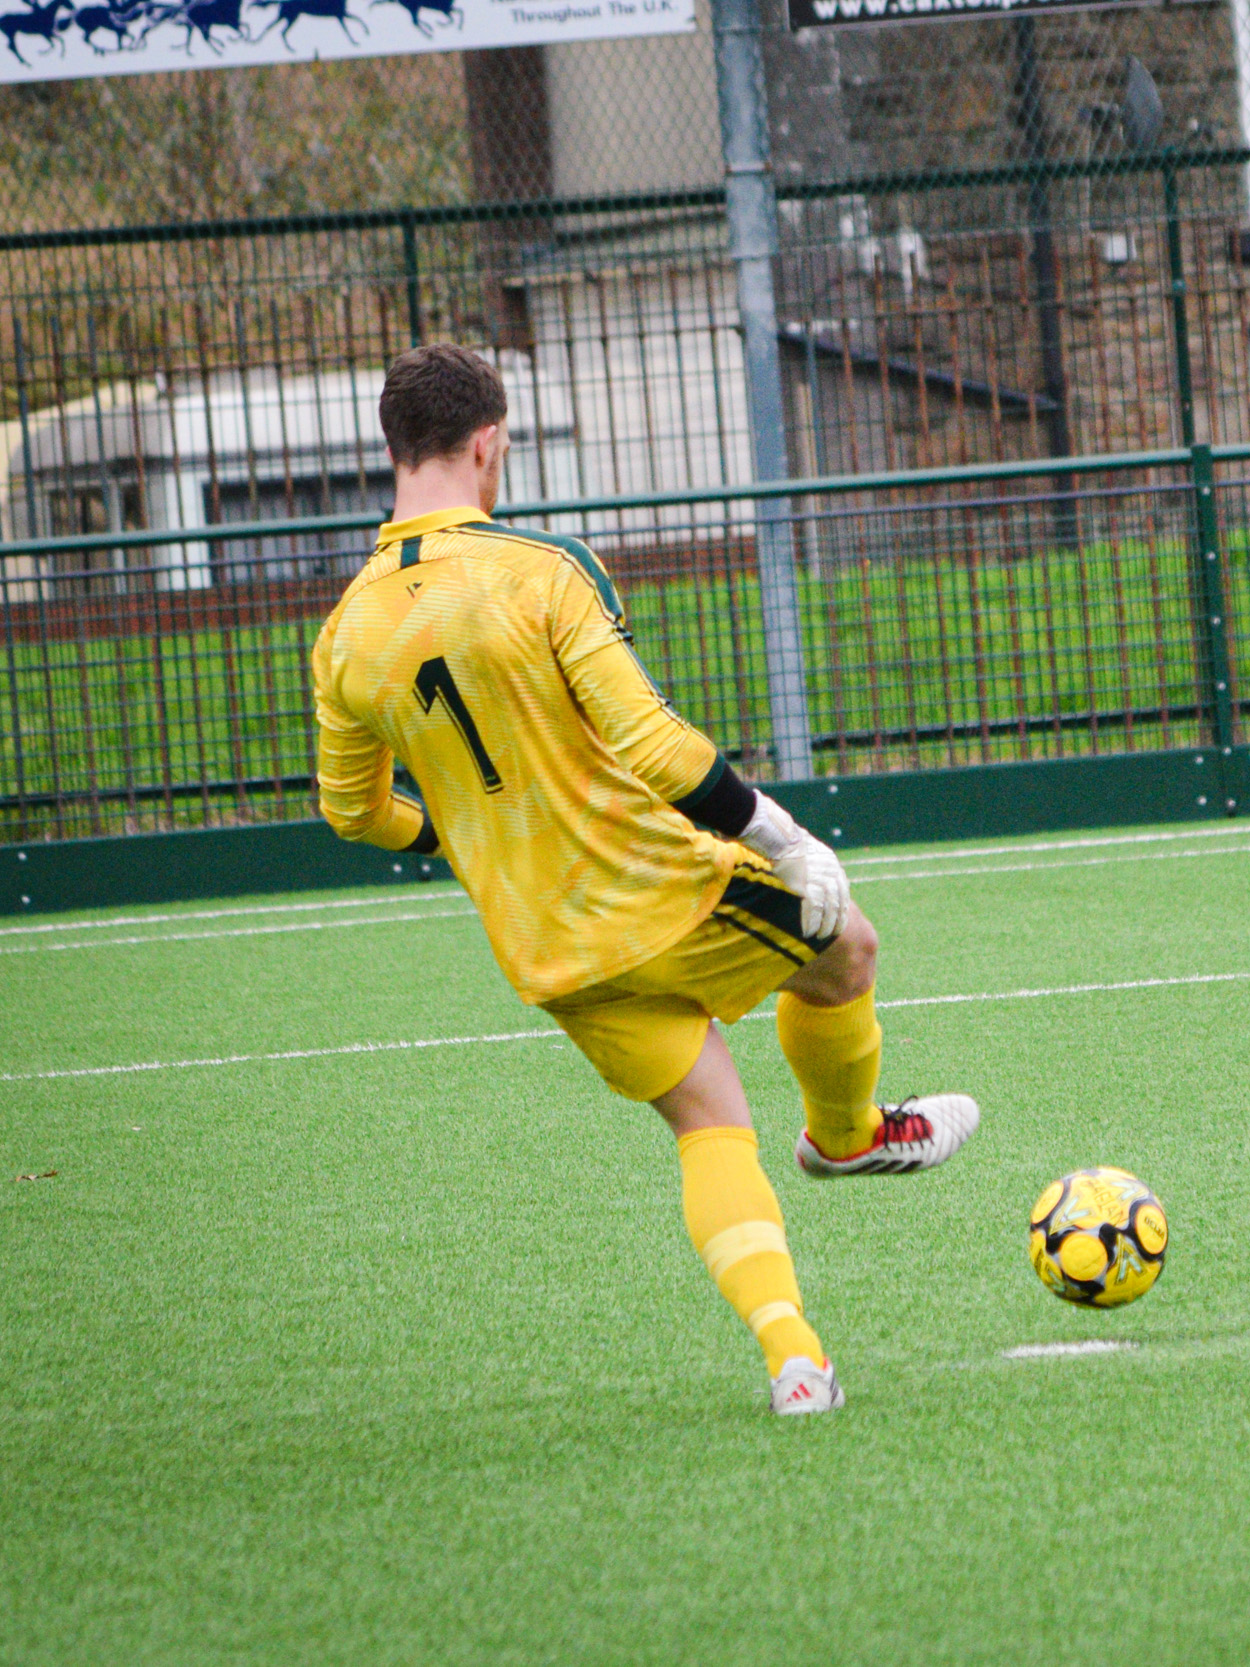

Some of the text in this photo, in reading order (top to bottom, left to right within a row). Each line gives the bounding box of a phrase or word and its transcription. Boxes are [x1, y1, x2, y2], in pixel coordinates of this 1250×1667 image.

[511, 5, 601, 23] Throughout
[608, 1, 636, 15] The
[412, 655, 505, 794] 1
